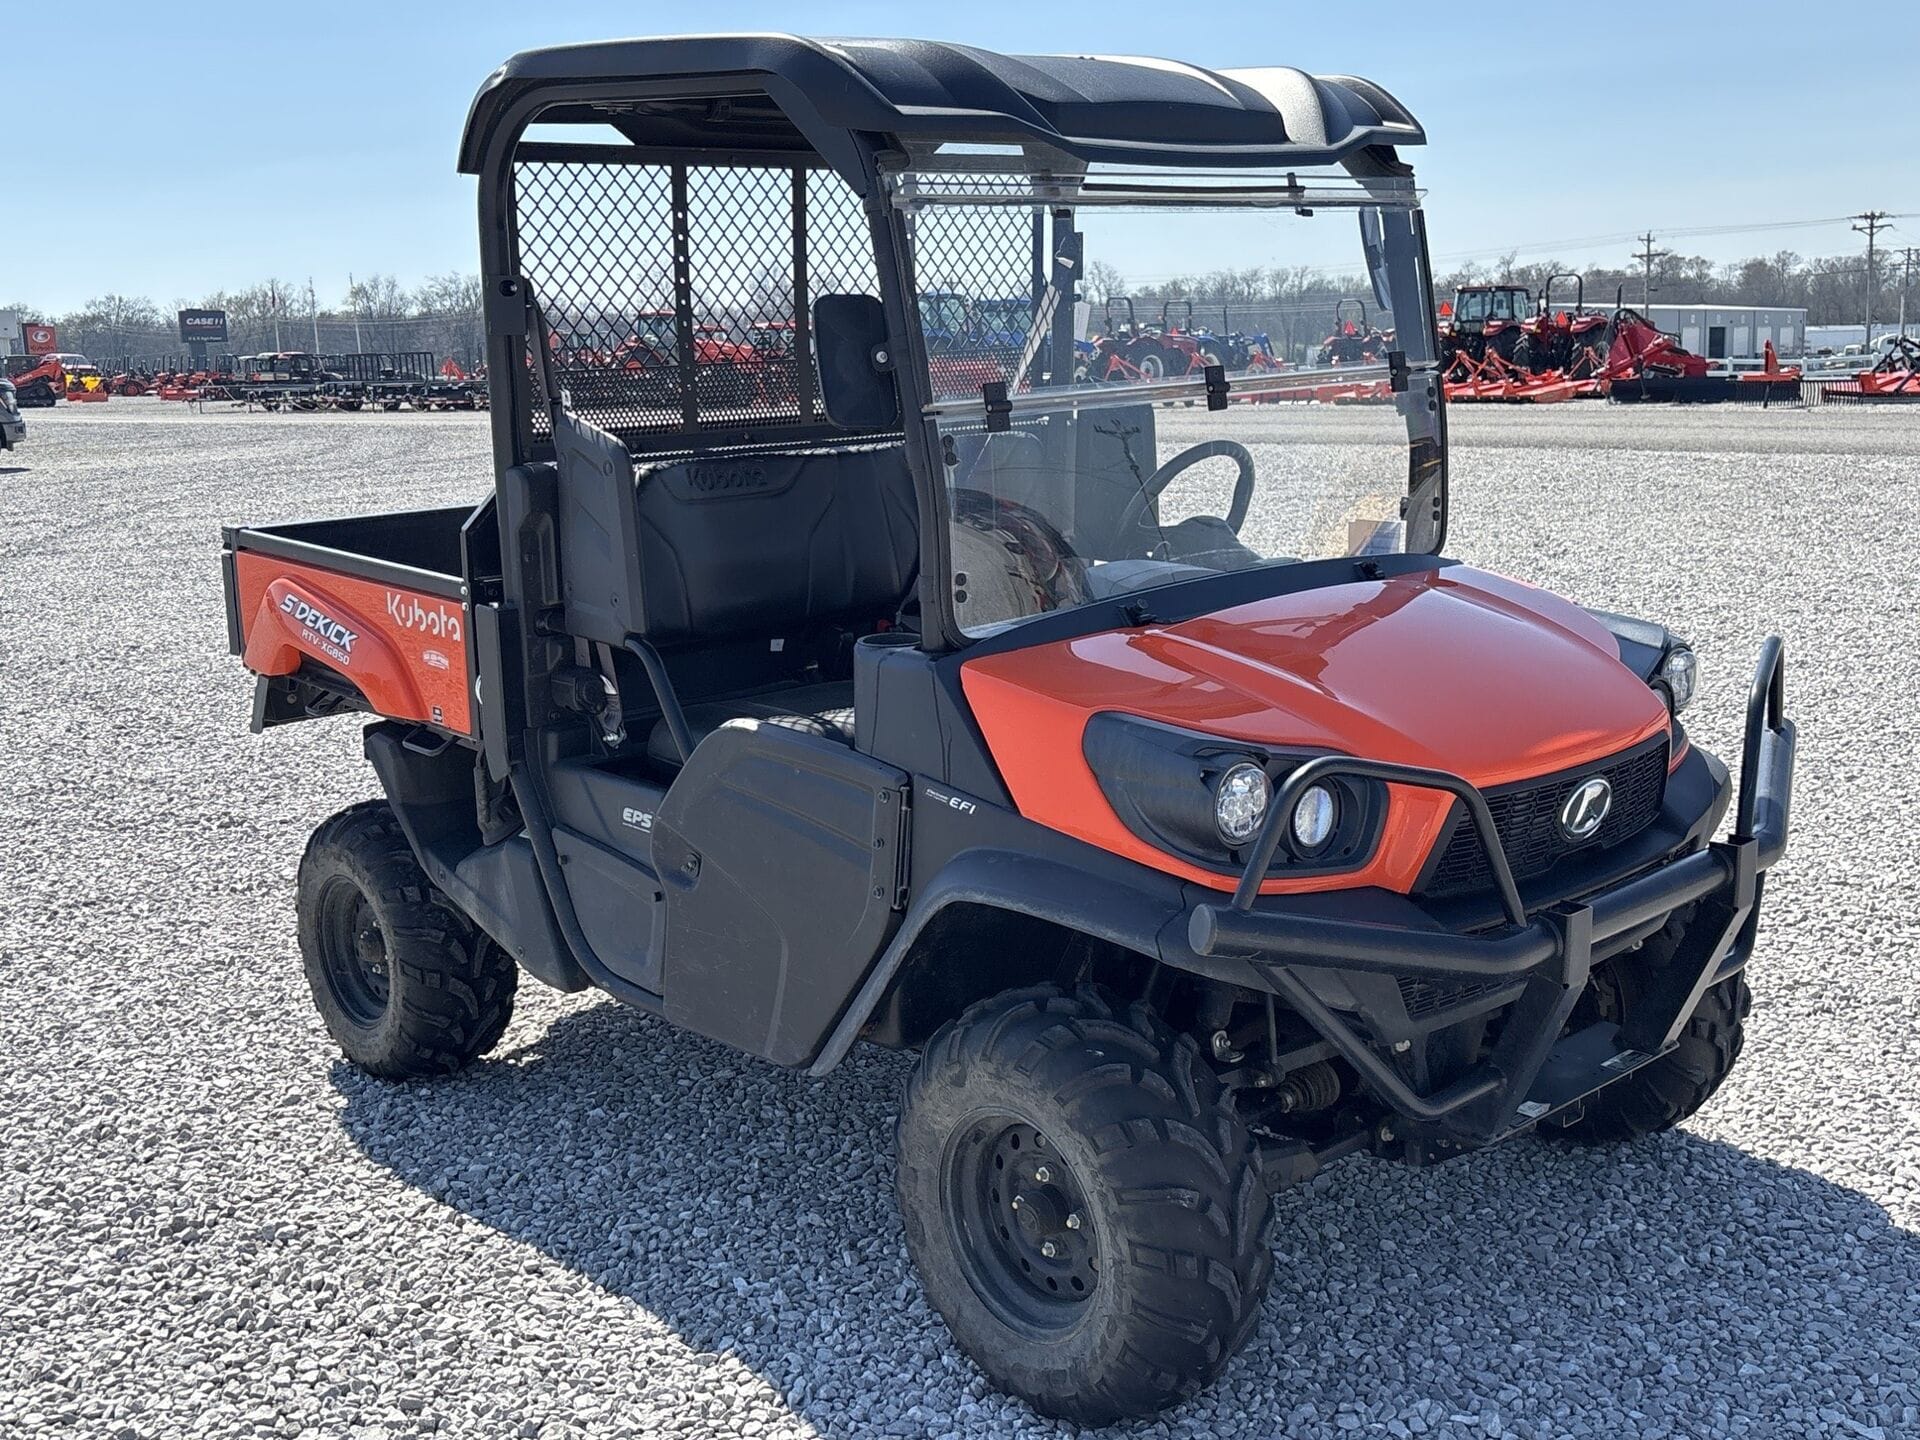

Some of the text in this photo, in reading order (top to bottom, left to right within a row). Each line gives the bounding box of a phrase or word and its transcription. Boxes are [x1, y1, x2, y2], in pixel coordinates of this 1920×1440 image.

[280, 593, 358, 653] SIDEKICK
[386, 591, 461, 642] Kubota
[301, 629, 350, 666] RTV-XG850
[622, 807, 653, 829] EPS
[949, 796, 977, 815] EFI
